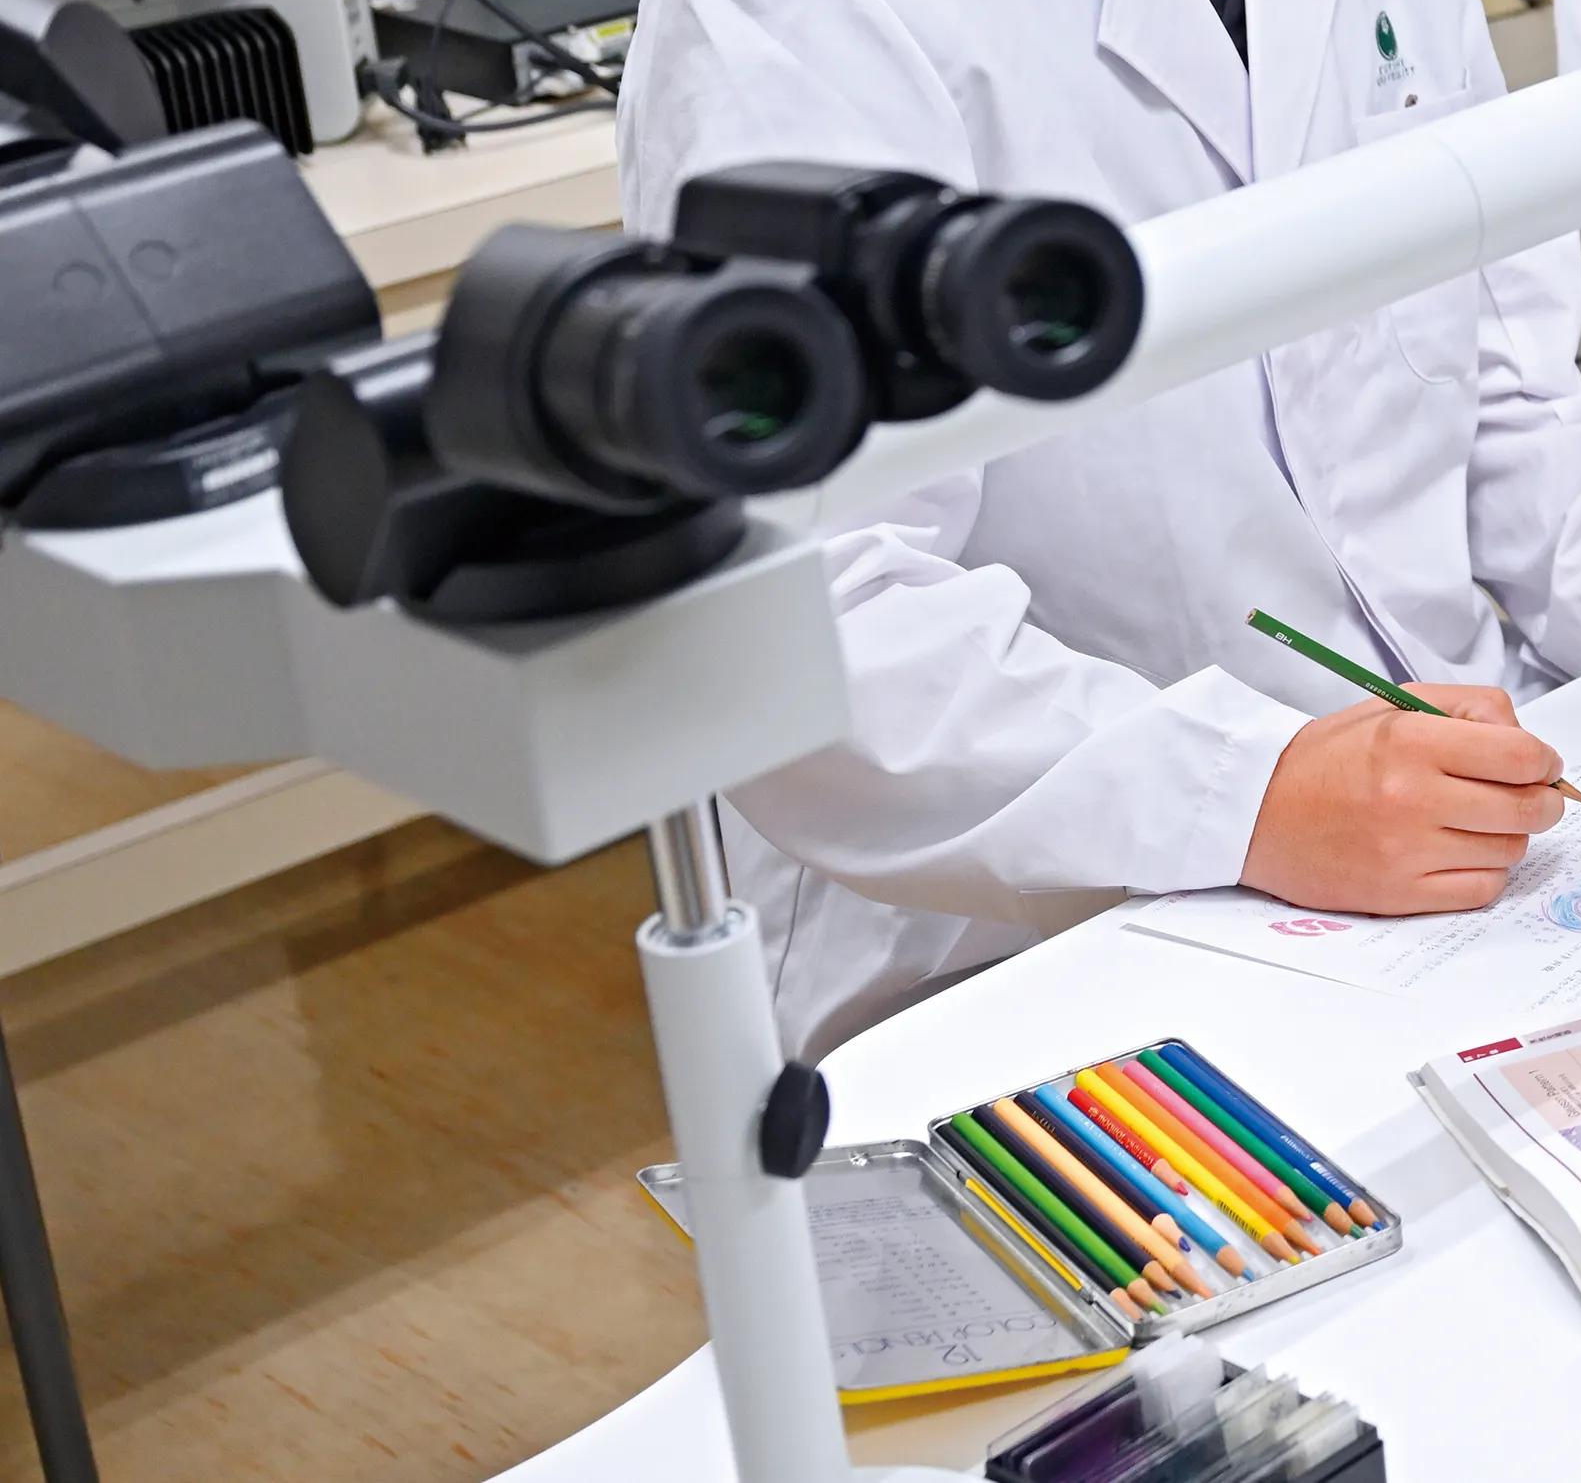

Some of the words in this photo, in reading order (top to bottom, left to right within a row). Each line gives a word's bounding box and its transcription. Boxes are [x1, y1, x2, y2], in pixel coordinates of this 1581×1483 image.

[1275, 632, 1292, 645] HB
[1528, 1065, 1538, 1077] 1
[1531, 1070, 1559, 1100] Pattern
[935, 1344, 982, 1365] 12
